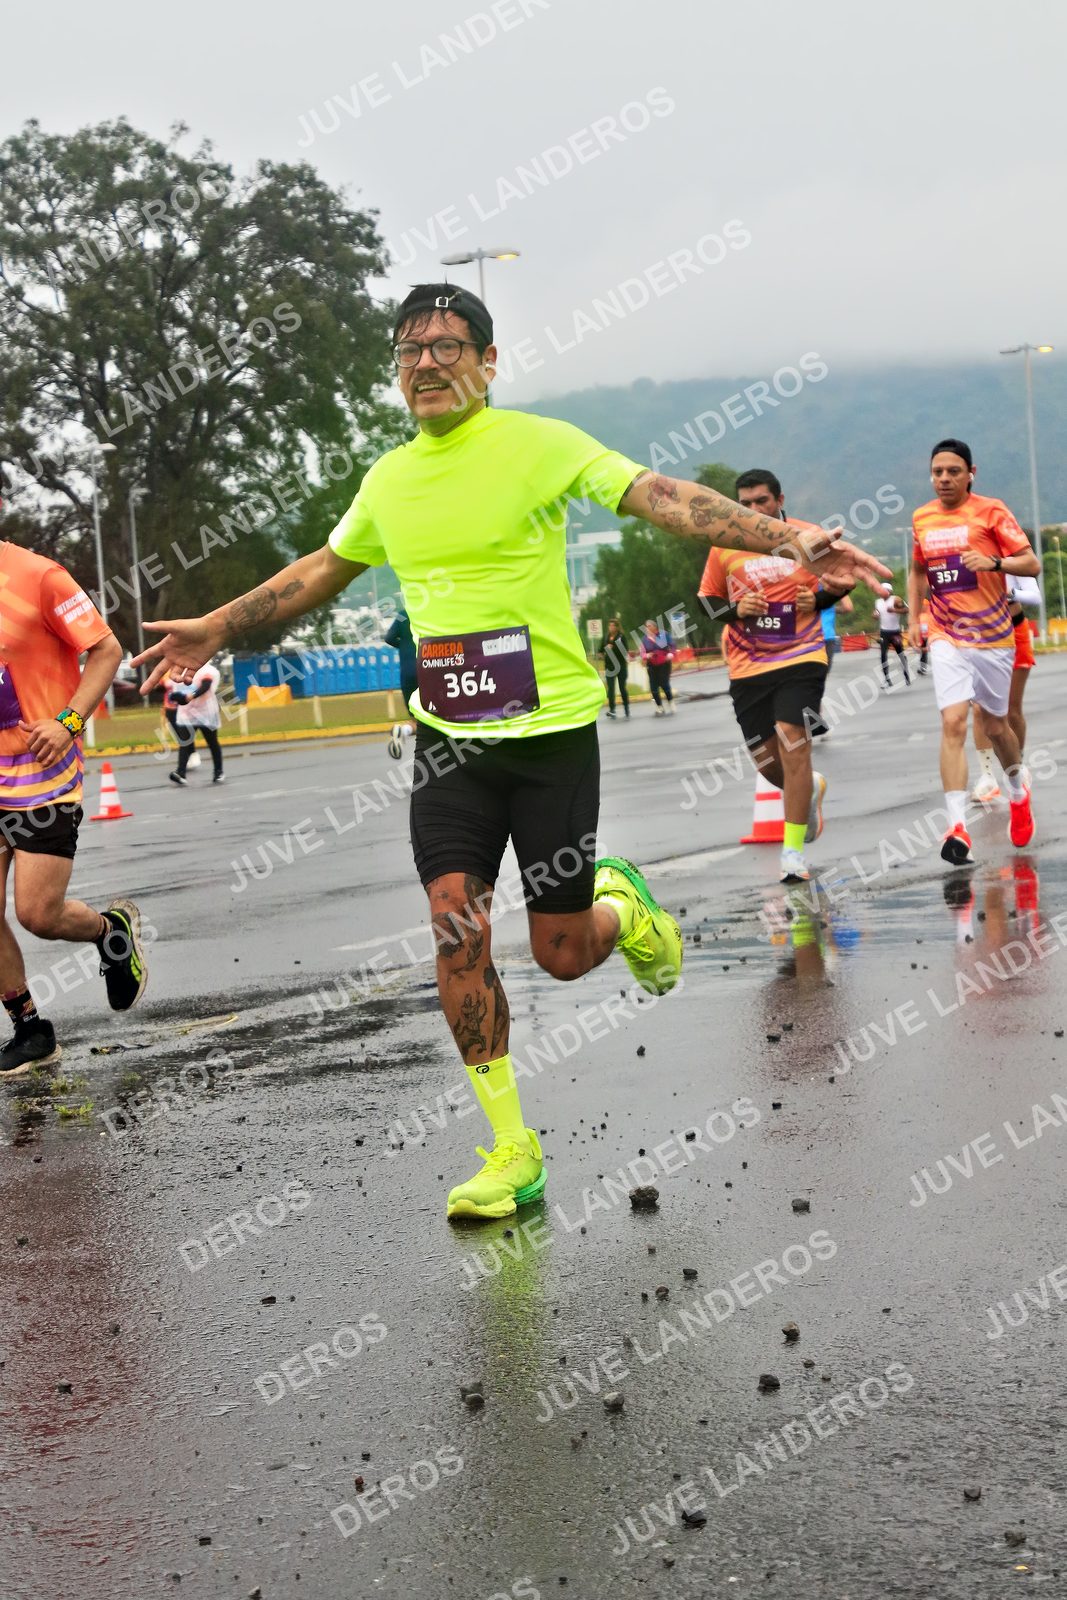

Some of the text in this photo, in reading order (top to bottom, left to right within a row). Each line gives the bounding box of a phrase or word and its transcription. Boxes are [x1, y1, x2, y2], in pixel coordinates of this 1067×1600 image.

[936, 569, 959, 584] 357
[756, 617, 781, 629] 495
[422, 641, 464, 658] CARRERA
[443, 670, 497, 698] 364
